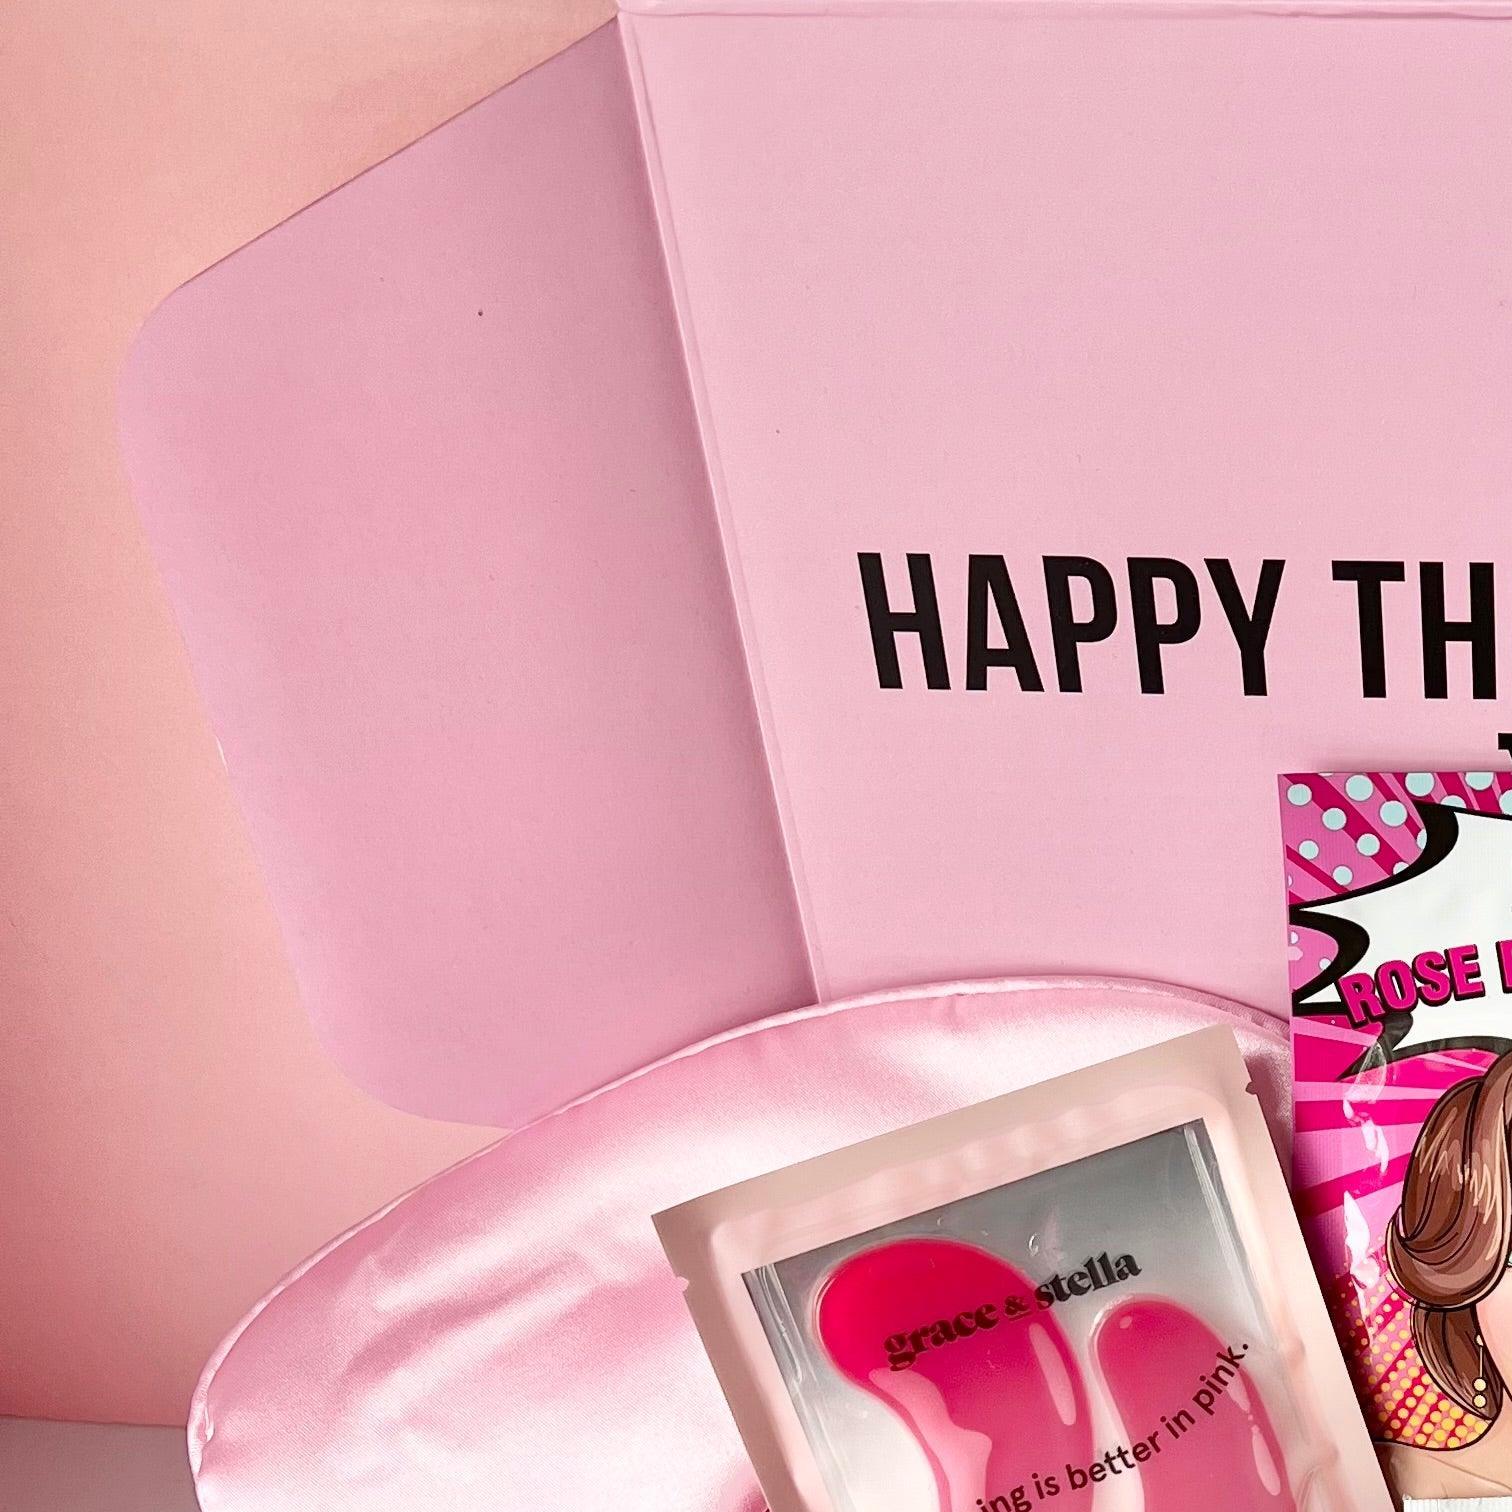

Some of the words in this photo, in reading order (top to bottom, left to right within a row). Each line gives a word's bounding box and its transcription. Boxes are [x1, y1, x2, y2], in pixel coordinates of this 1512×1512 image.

[857, 552, 1286, 697] HAPPY
[1338, 945, 1486, 1029] ROSE
[884, 1304, 1000, 1371] grace
[1004, 1296, 1031, 1322] &
[1034, 1252, 1142, 1310] stella
[1032, 1472, 1060, 1500] is
[1066, 1431, 1163, 1491] better
[1160, 1408, 1196, 1440] in
[1192, 1343, 1249, 1416] pink.
